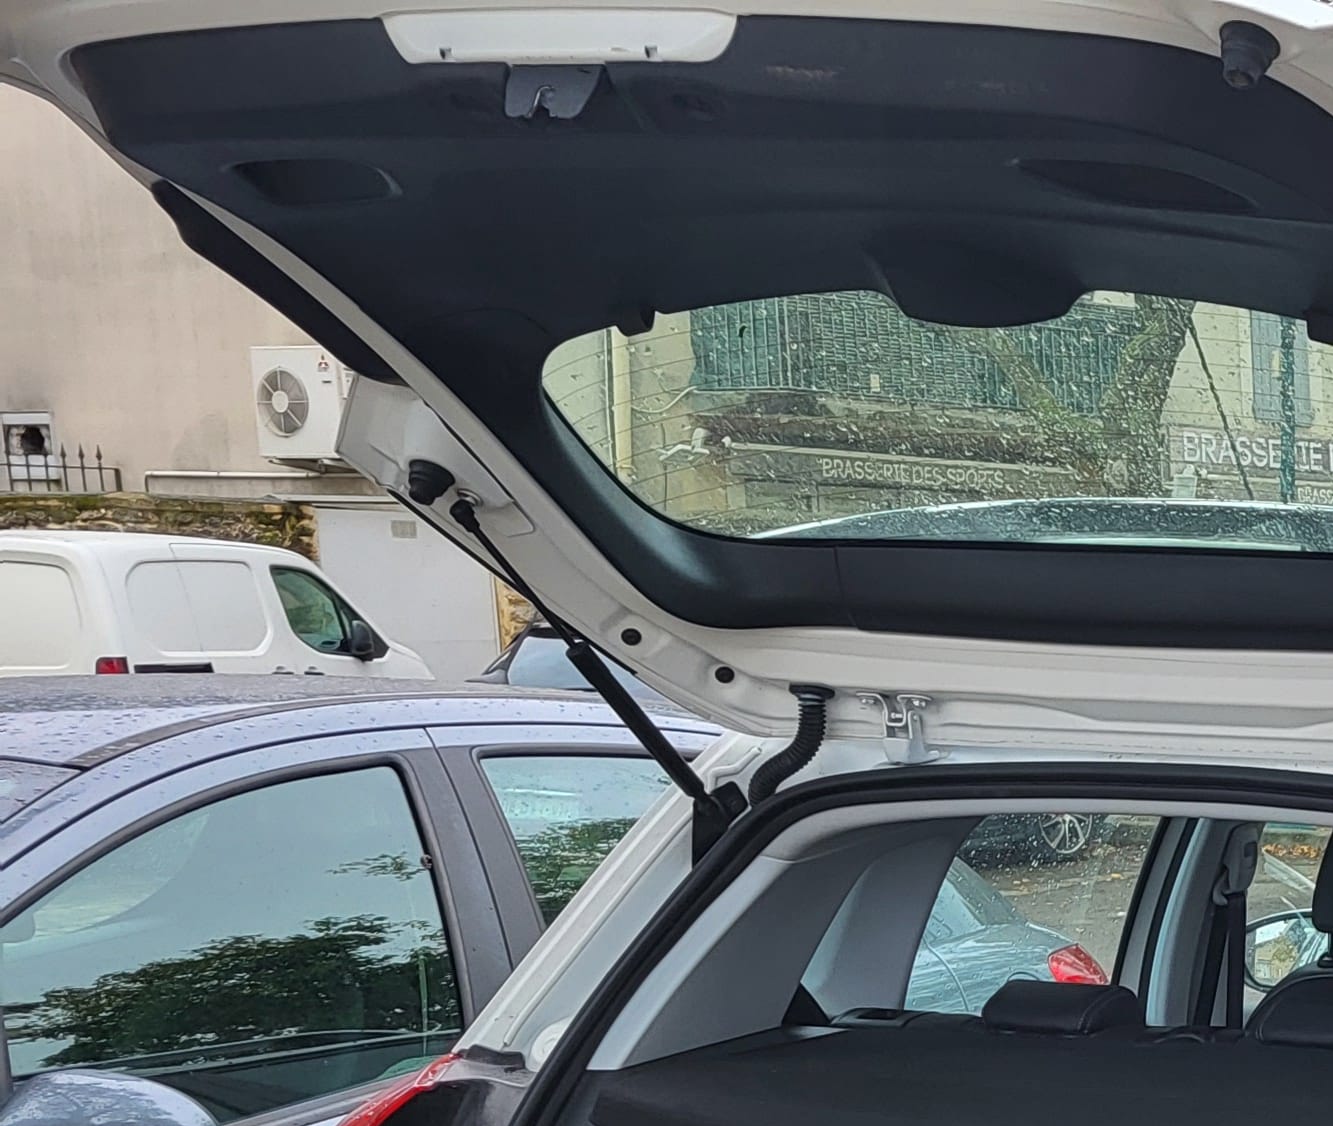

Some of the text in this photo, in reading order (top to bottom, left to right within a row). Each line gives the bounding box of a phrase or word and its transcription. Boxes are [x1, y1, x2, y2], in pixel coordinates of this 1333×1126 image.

[1183, 431, 1322, 471] BRASSEIE
[911, 466, 942, 486] DES
[947, 468, 1004, 489] SPORTS
